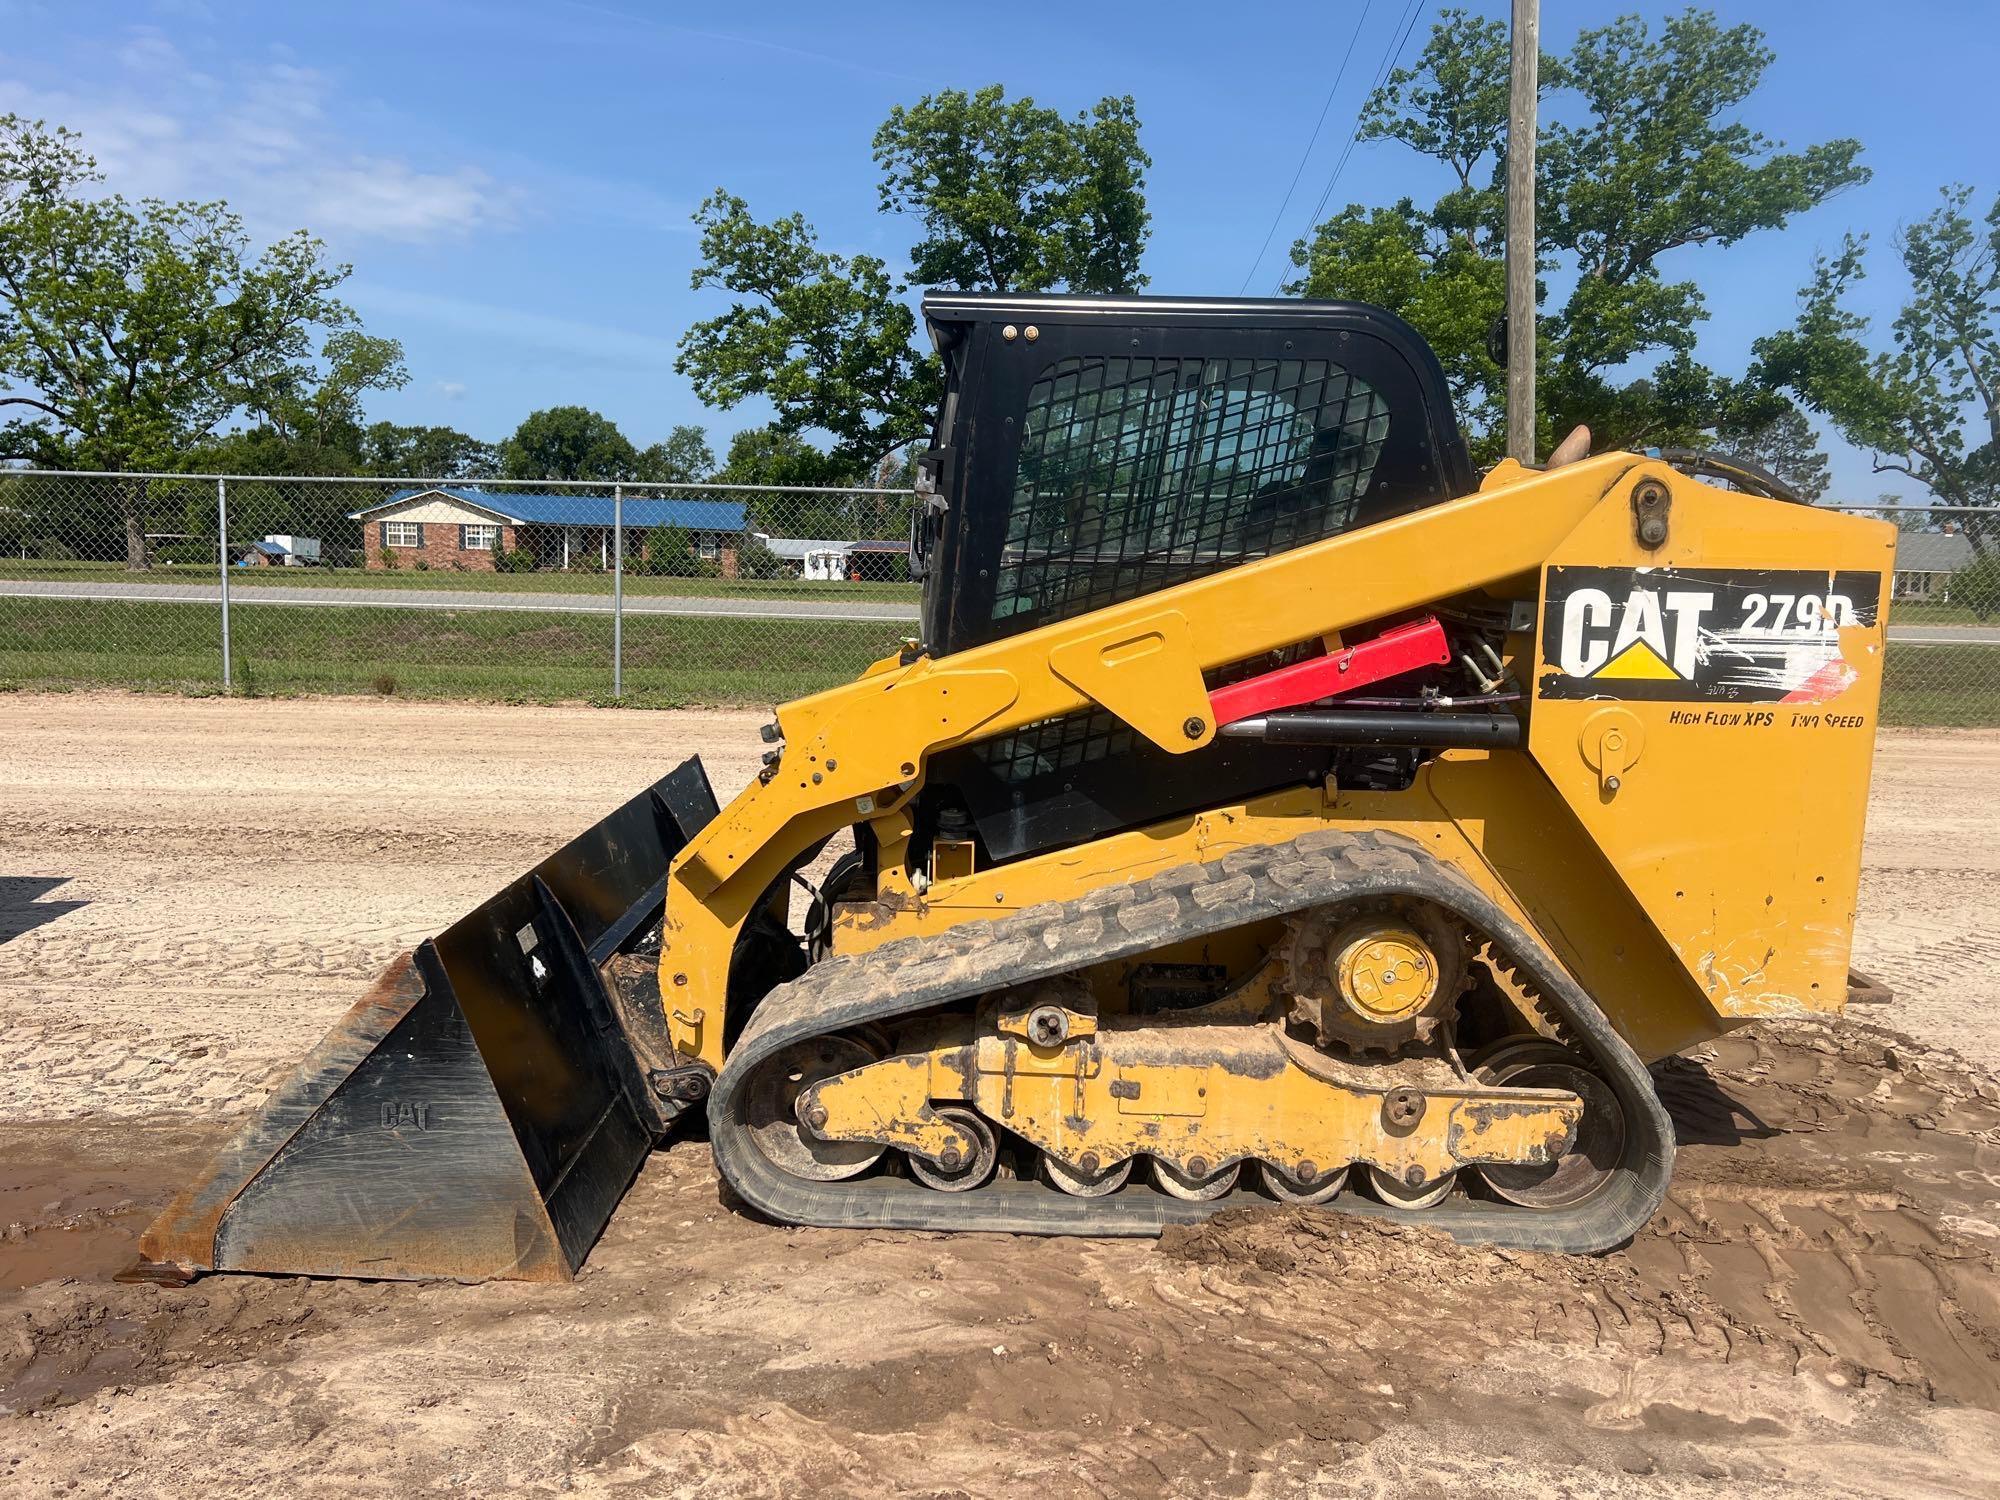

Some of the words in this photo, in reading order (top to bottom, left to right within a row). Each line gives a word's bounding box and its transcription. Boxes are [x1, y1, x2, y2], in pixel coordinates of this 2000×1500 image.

[1560, 588, 1715, 681] CAT
[1740, 593, 1855, 638] 279D
[1669, 710, 1701, 725] HIGH
[1743, 712, 1775, 727] XPS
[381, 1101, 431, 1131] CAT
